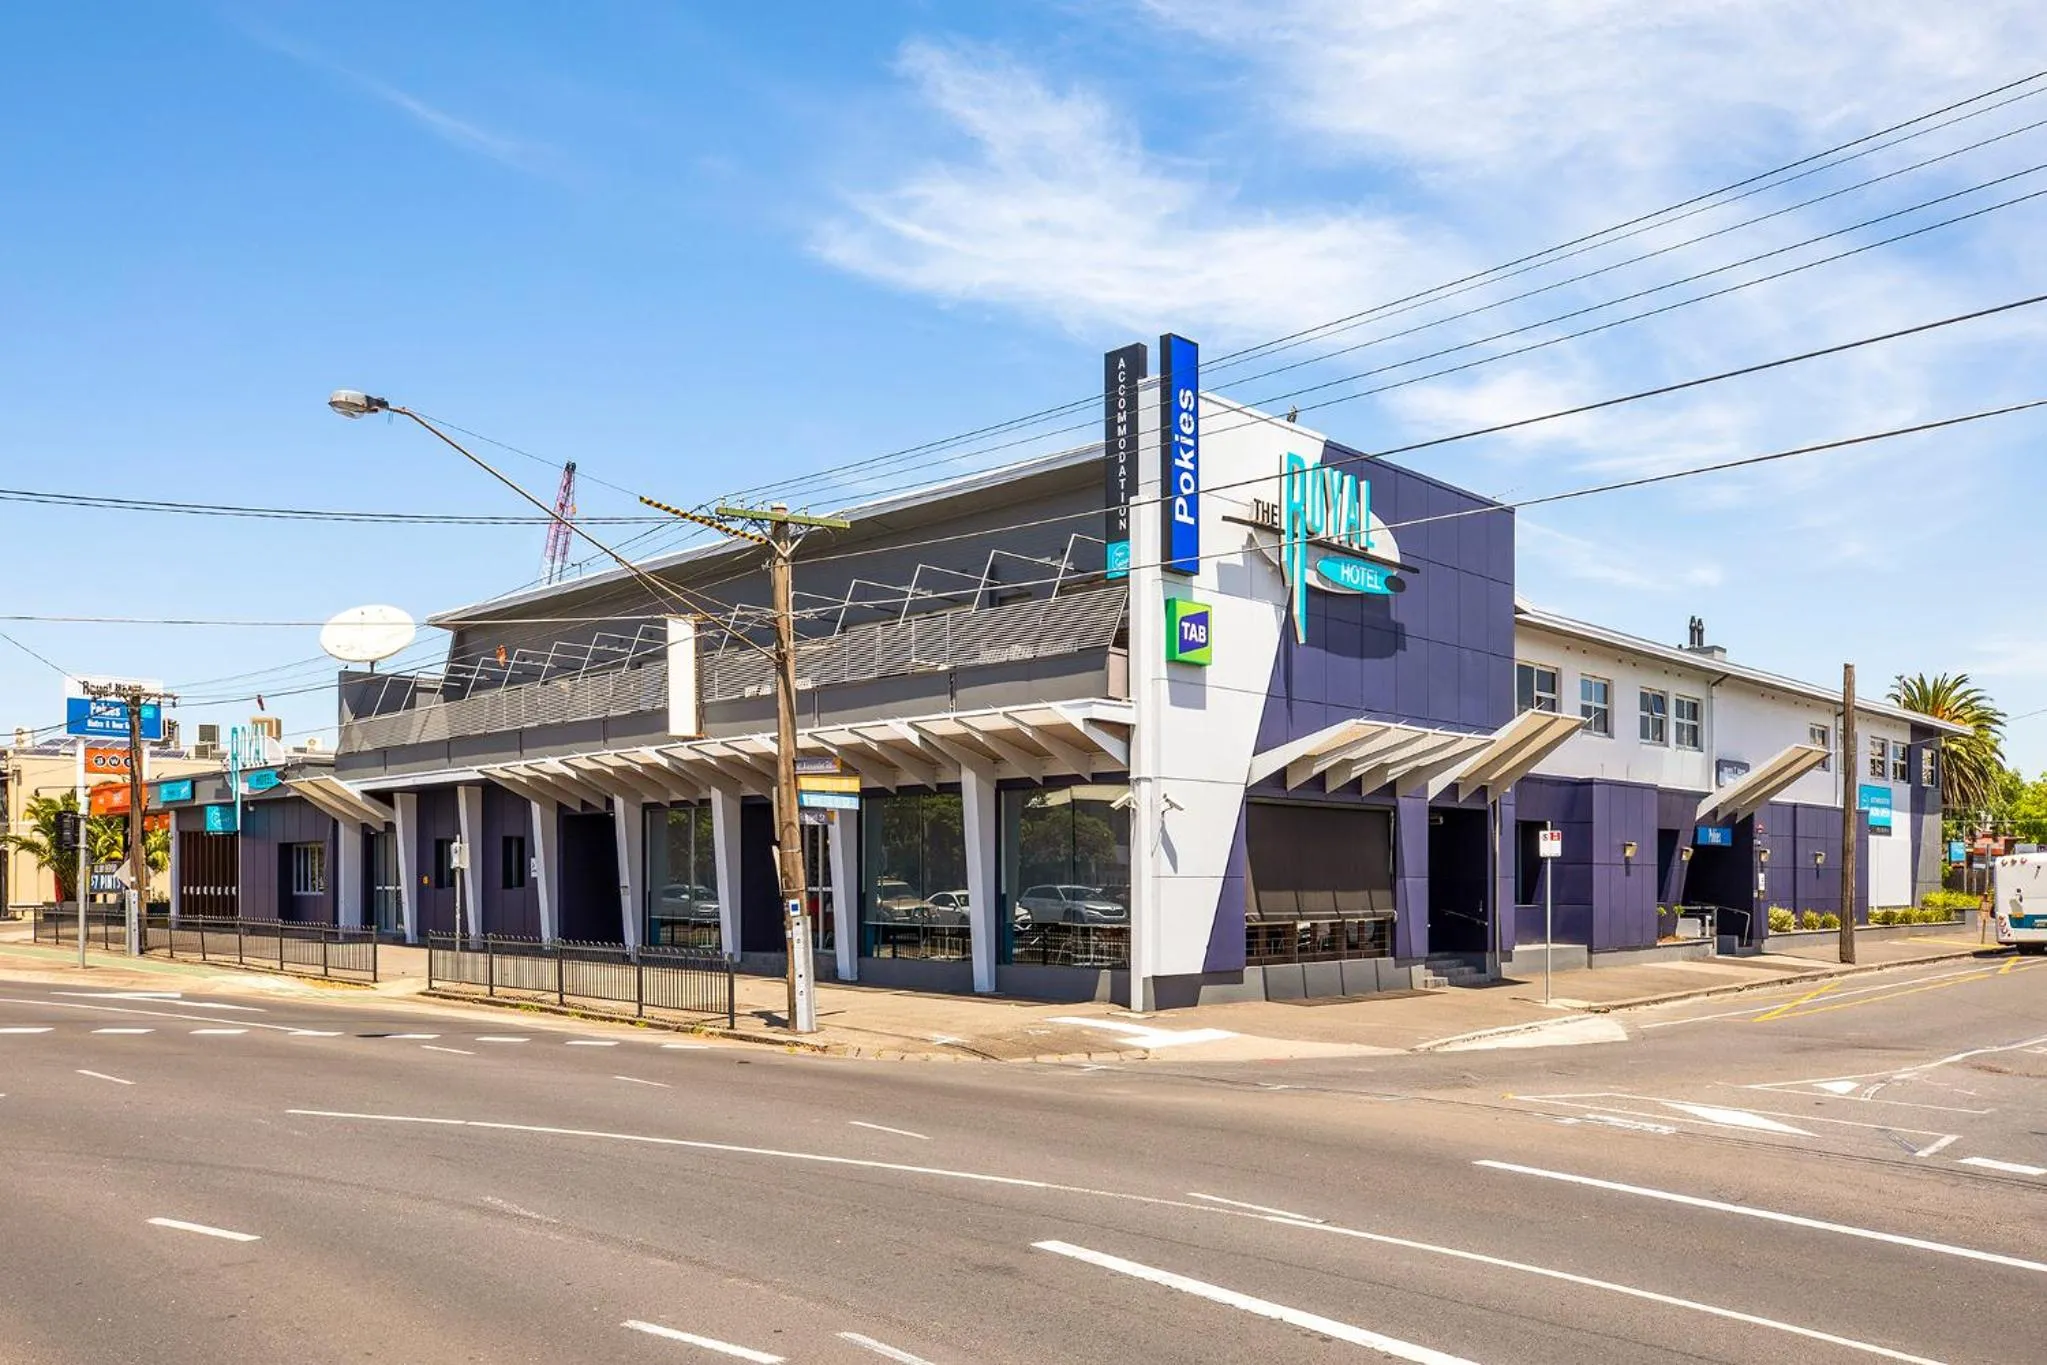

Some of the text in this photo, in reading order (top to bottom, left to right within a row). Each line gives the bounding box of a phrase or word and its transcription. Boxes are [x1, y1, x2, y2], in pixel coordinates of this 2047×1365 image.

[1116, 356, 1128, 532] ACCOMMODATION
[1173, 388, 1196, 526] Pokies
[1253, 498, 1279, 527] THE
[1282, 451, 1376, 645] ROYAL
[1340, 562, 1383, 590] HOTEL
[1181, 622, 1208, 643] TAB
